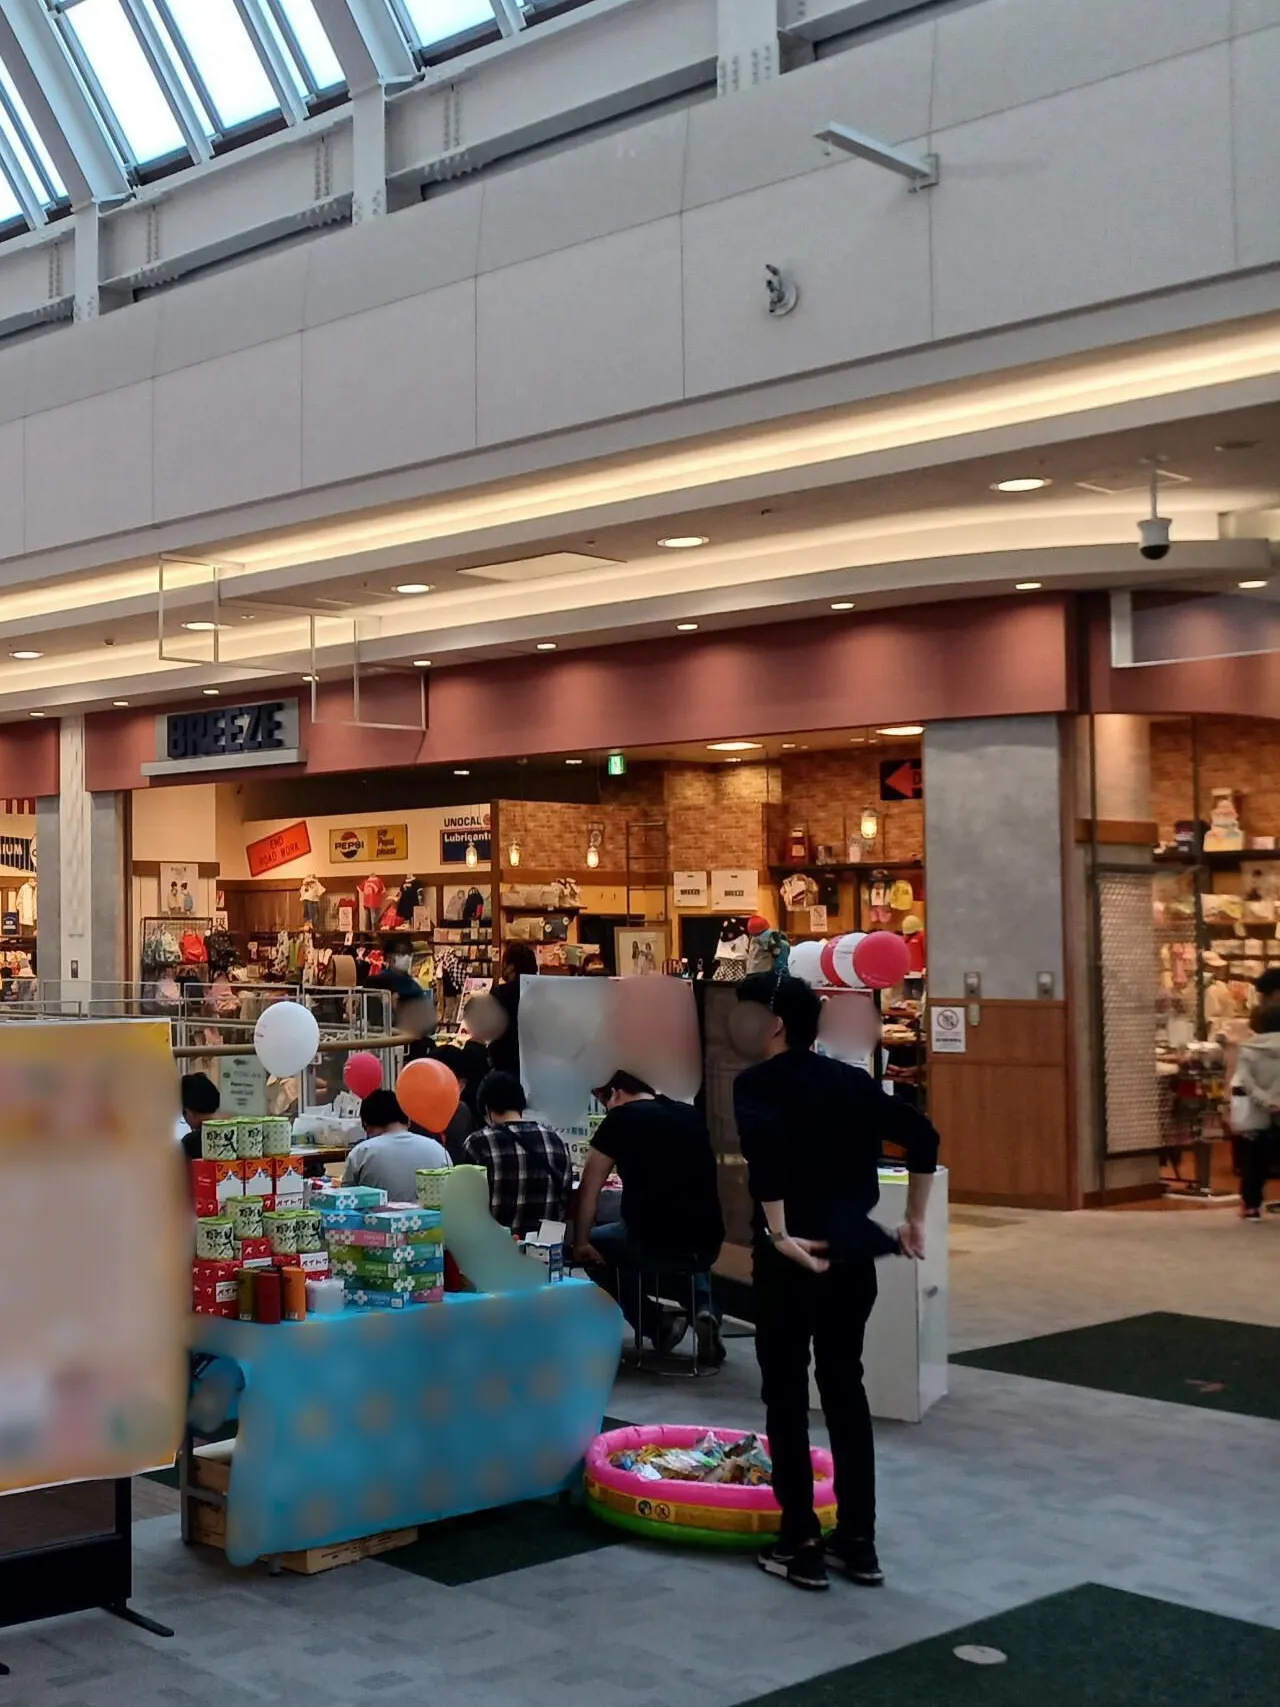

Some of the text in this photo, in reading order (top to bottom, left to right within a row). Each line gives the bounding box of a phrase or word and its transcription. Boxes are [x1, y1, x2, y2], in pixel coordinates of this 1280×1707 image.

[168, 703, 283, 759] BREEZE
[443, 816, 482, 828] UNOCAL
[269, 835, 284, 849] END
[334, 840, 365, 850] PEPSI
